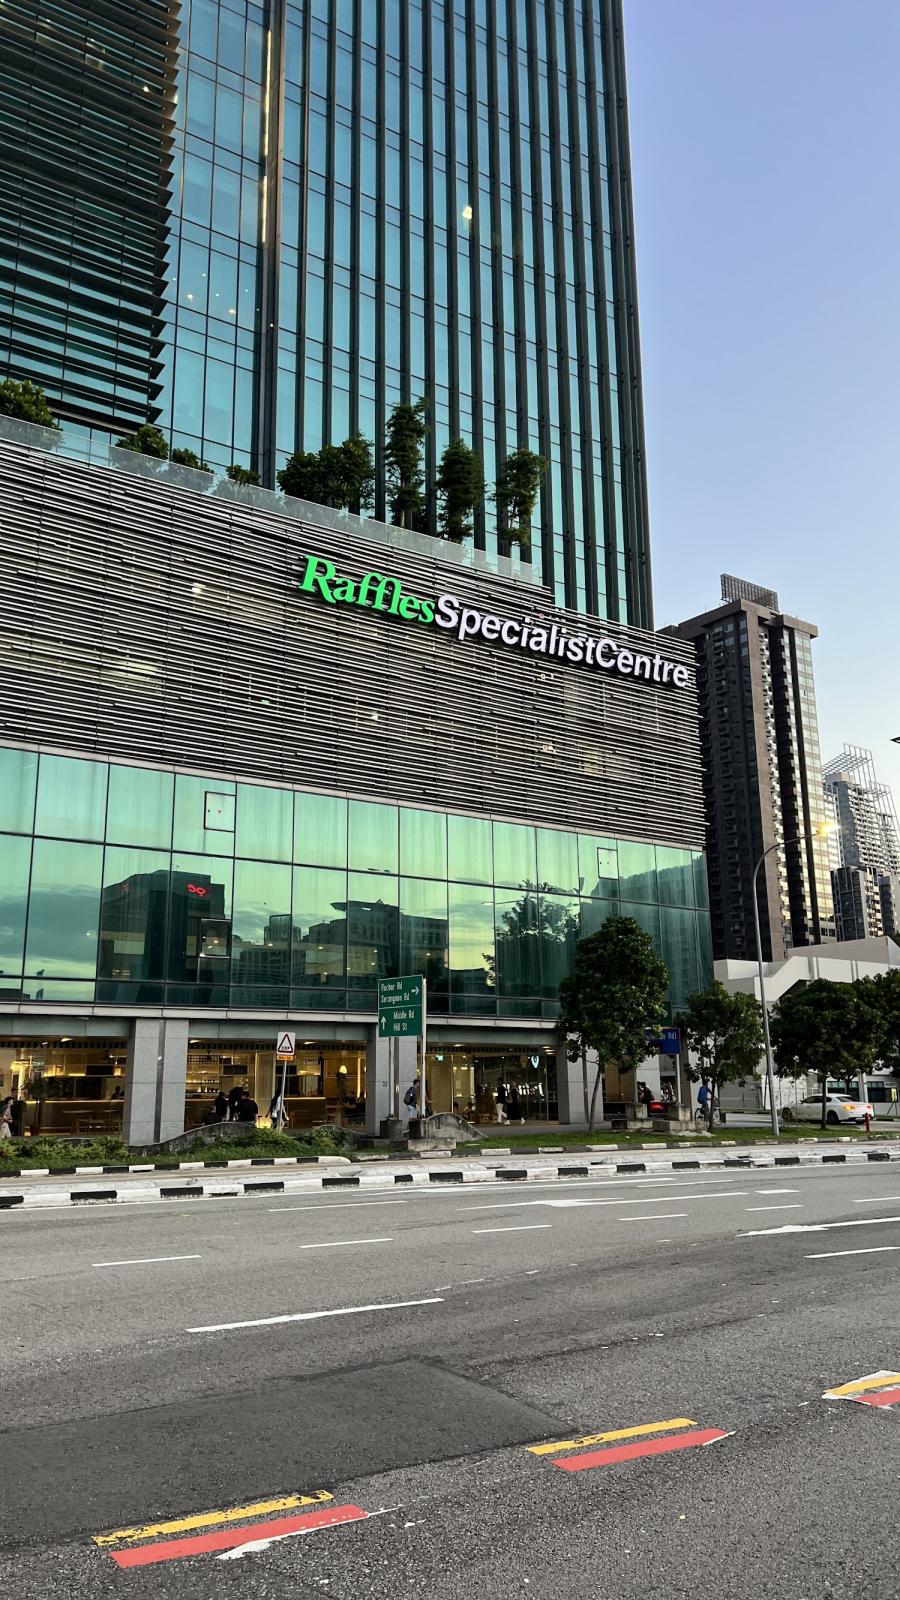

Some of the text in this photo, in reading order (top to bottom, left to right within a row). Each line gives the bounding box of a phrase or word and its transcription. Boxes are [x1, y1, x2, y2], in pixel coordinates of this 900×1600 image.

[299, 554, 436, 623] Raffles
[396, 981, 403, 990] Rd
[403, 992, 410, 1001] Rd
[393, 1009, 415, 1020] Middle Rd
[393, 1022, 408, 1032] Hill St
